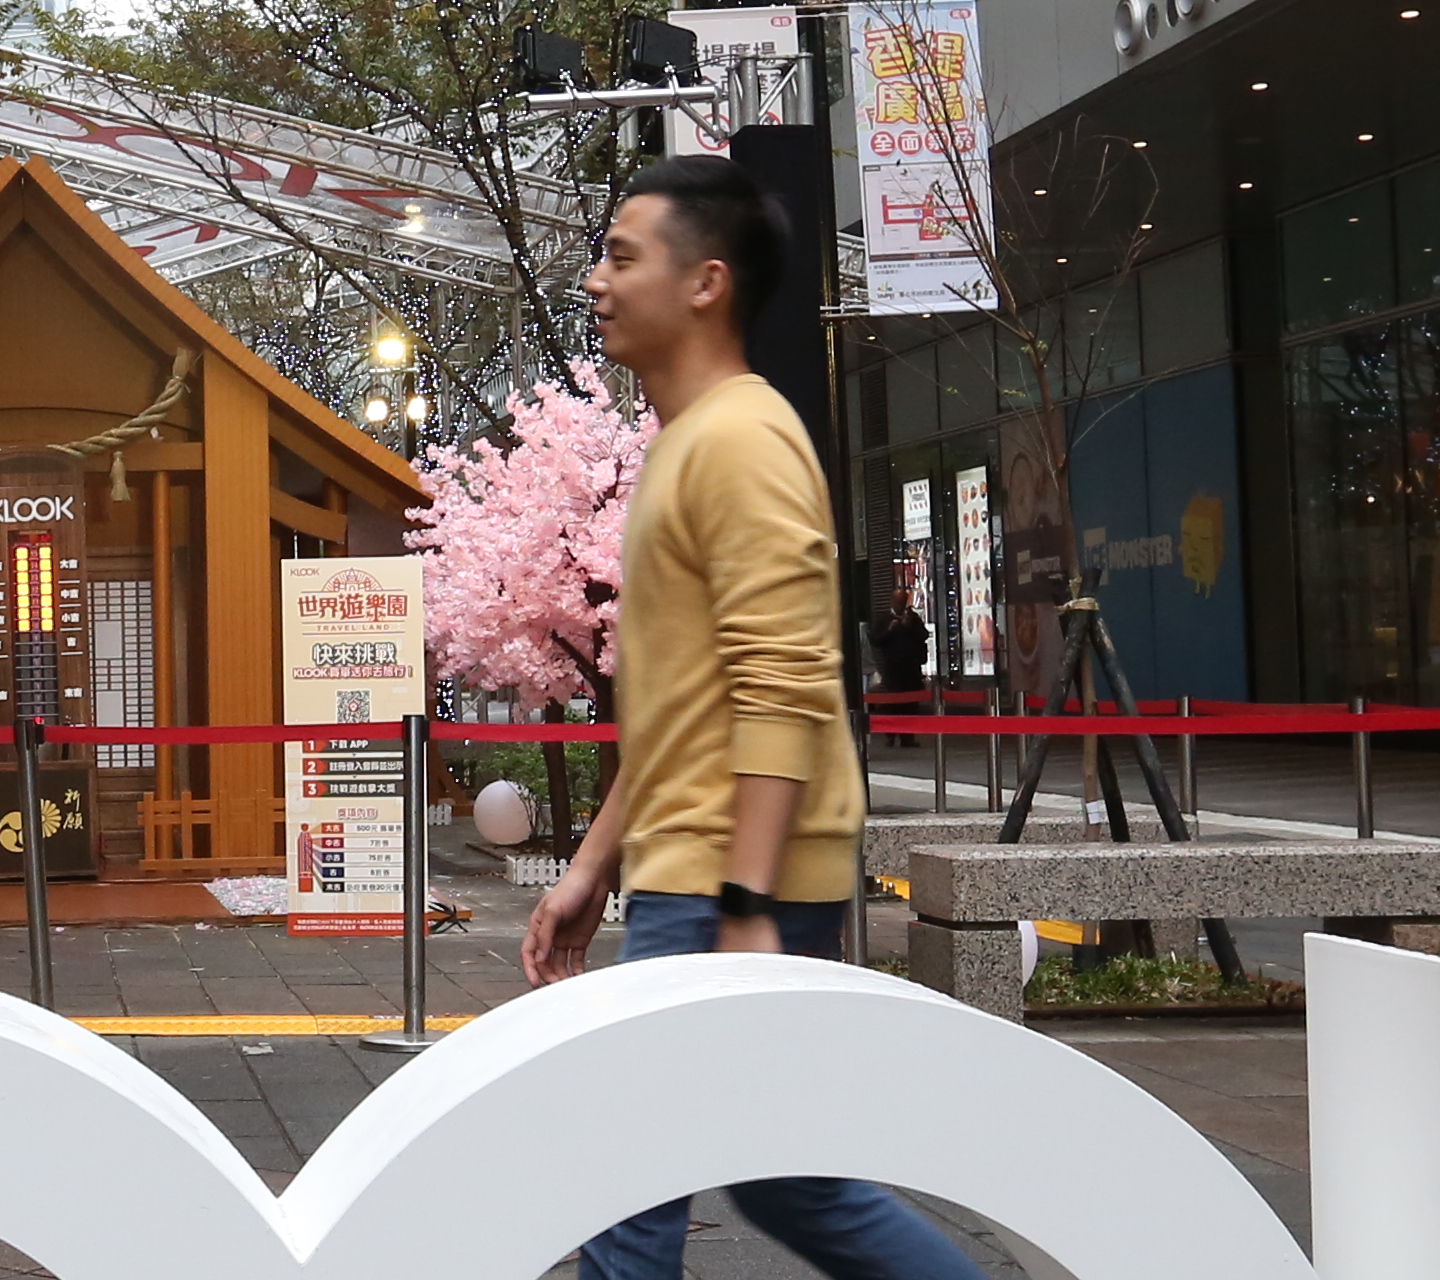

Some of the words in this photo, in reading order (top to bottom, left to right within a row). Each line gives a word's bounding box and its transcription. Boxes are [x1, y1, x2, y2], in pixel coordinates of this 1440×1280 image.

[876, 81, 966, 125] 廣場
[1108, 534, 1174, 570] MONSTER
[59, 559, 78, 569] 大吉
[290, 568, 320, 577] KLOOK
[60, 588, 79, 599] 中吉
[297, 593, 408, 622] 世界遊樂園
[61, 612, 80, 623] 小吉
[313, 643, 396, 665] 快來挑戰
[293, 667, 328, 678] KLOOK
[308, 740, 315, 751] 1
[349, 740, 369, 749] APP
[307, 761, 316, 773] 2
[307, 783, 317, 795] 3
